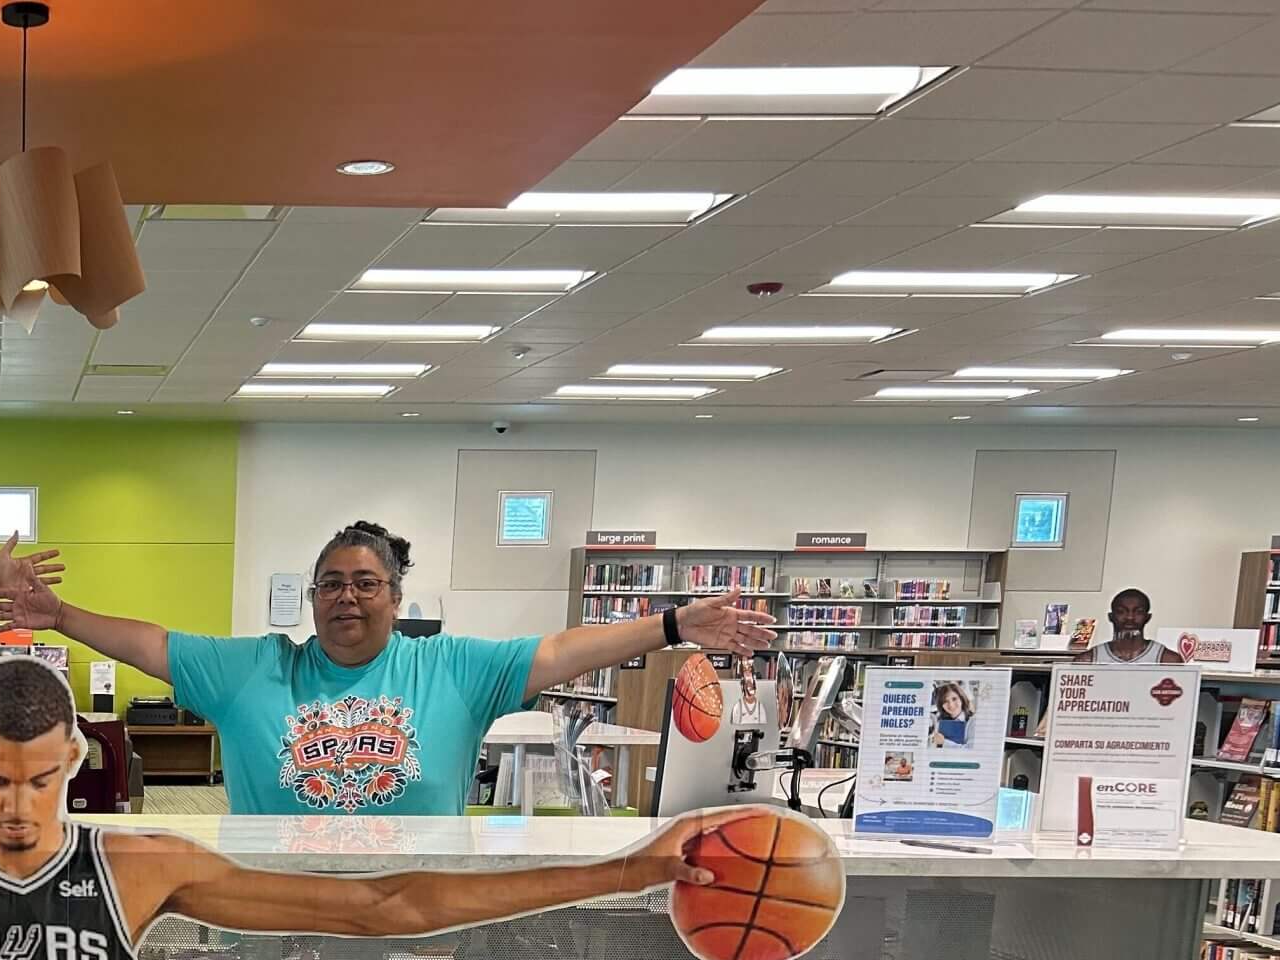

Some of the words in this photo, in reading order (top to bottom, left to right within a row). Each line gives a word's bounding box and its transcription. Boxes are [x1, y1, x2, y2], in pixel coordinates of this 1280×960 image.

[597, 533, 621, 544] large
[623, 533, 646, 544] print
[1060, 674, 1095, 687] SHARE
[882, 693, 917, 704] QUIERES
[1059, 687, 1087, 699] YOUR
[881, 706, 925, 717] APRENDER
[1057, 700, 1130, 713] APPRECIATION
[880, 718, 915, 729] INGLES?
[302, 735, 396, 763] SPURS
[1054, 740, 1094, 750] COMPARTA
[1094, 740, 1106, 750] SU
[1106, 741, 1171, 751] AGRADECIMIENTO
[1096, 782, 1158, 793] enCORE
[58, 880, 99, 898] Self.
